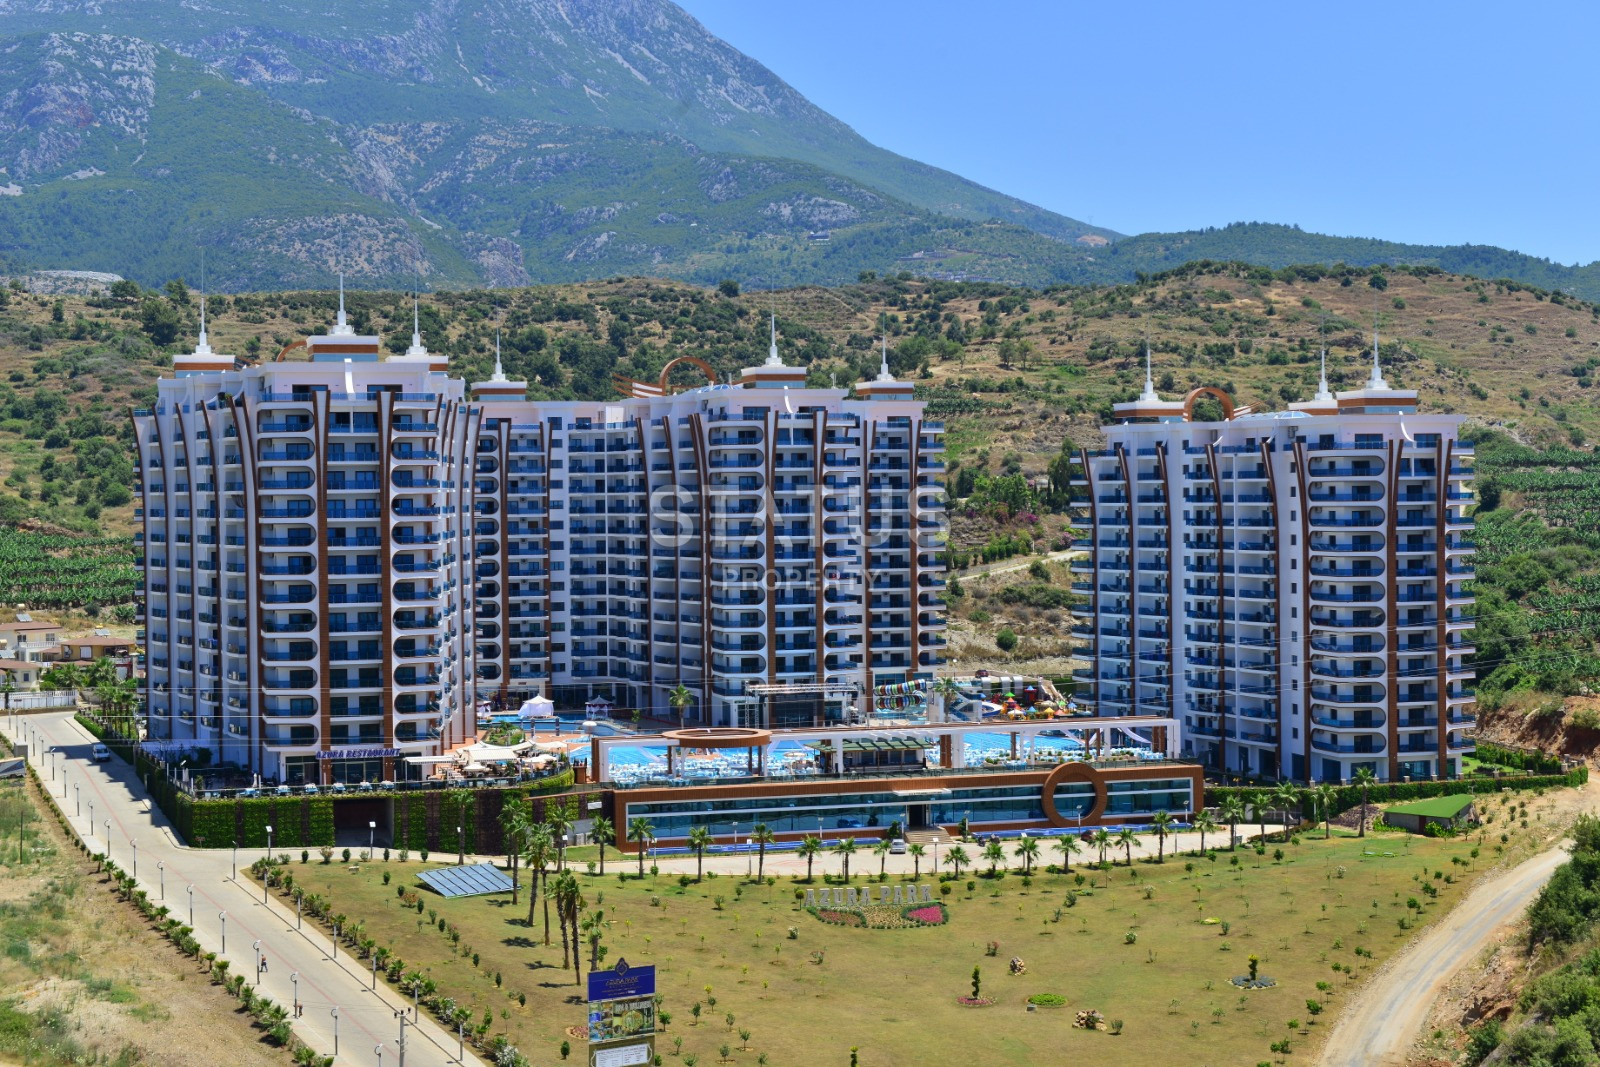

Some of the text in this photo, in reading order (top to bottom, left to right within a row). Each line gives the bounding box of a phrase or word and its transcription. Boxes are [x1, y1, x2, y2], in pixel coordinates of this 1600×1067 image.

[346, 748, 400, 758] RESTAURANT
[804, 884, 932, 906] AZURA PARK
